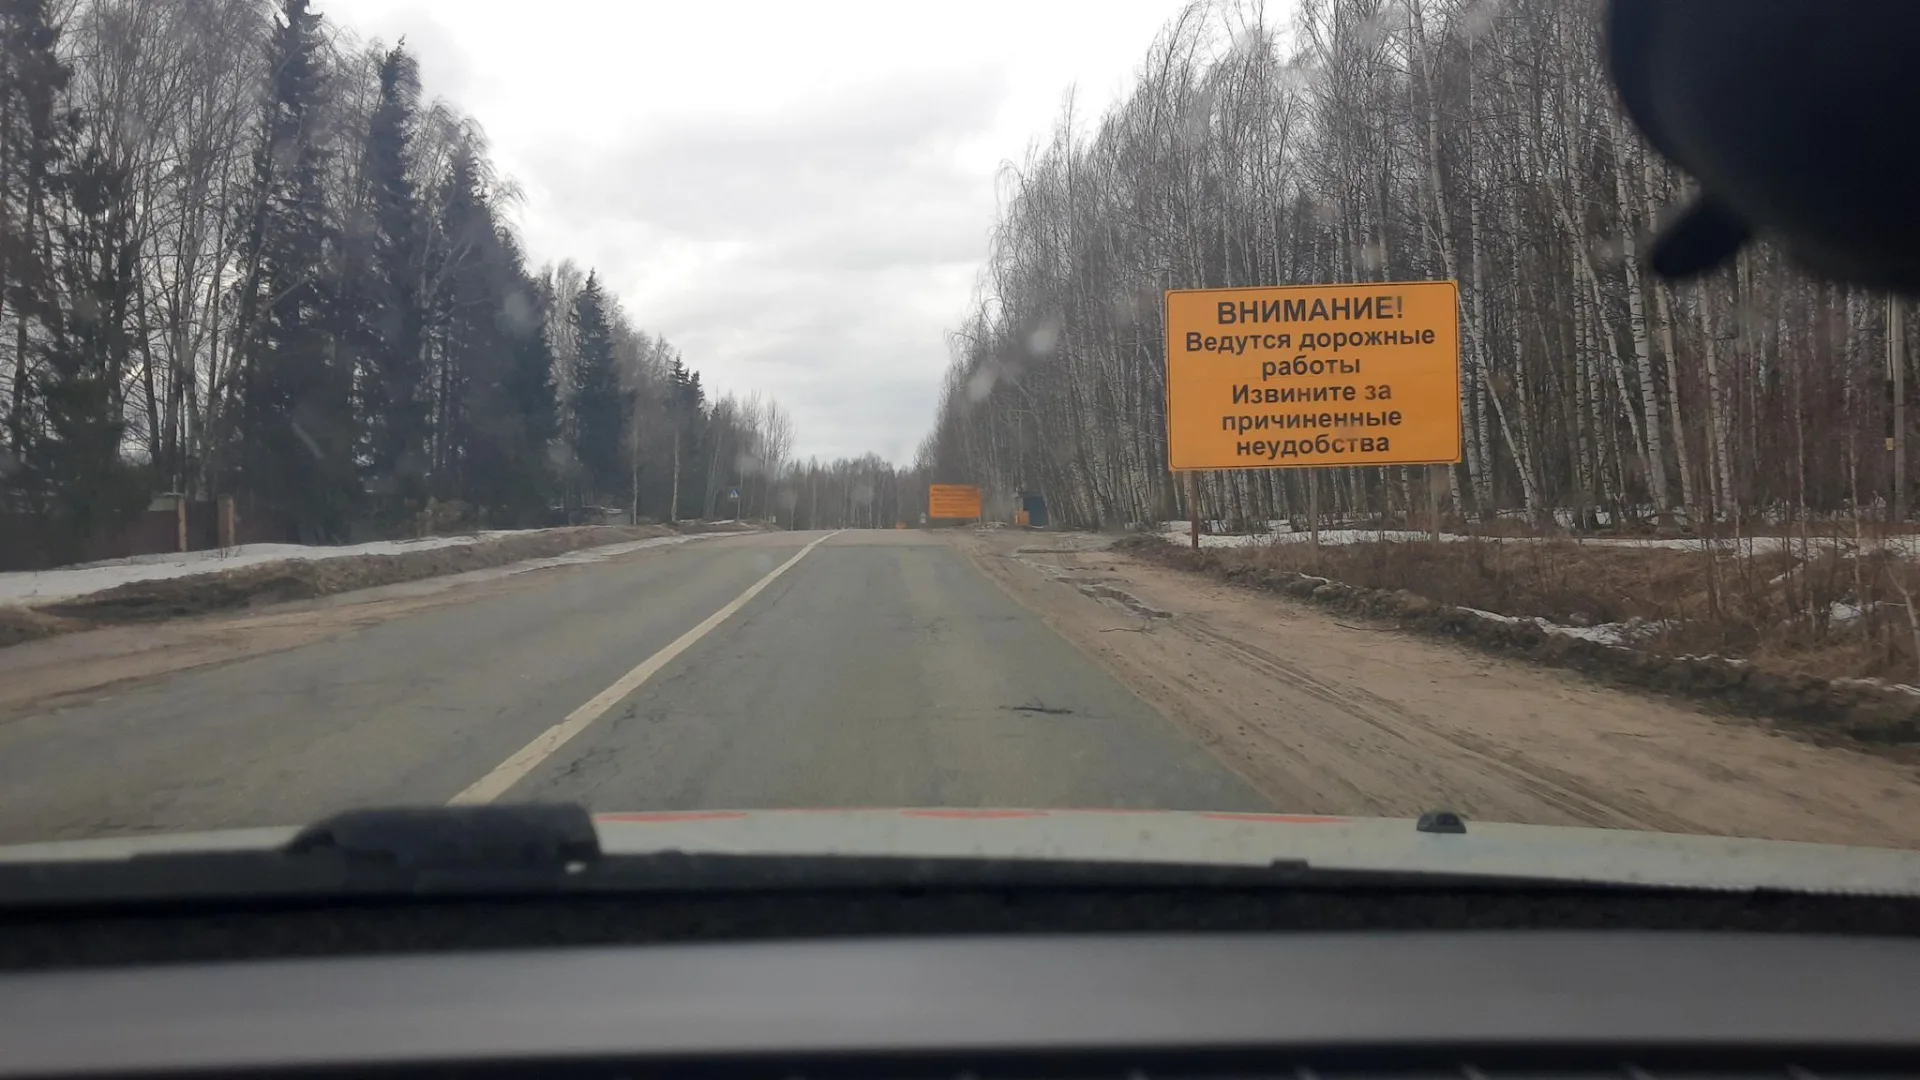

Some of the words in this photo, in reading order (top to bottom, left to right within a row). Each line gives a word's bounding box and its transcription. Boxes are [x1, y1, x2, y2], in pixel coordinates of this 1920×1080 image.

[1217, 296, 1403, 325] ВНИМАНИЕ!
[1186, 332, 1291, 355] Ведутся
[1299, 328, 1435, 353] дорожные
[1262, 355, 1360, 380] работы
[1233, 384, 1356, 404] Извините
[1365, 385, 1391, 400] за
[1222, 410, 1402, 435] причиненные
[1237, 434, 1389, 460] неудобства
